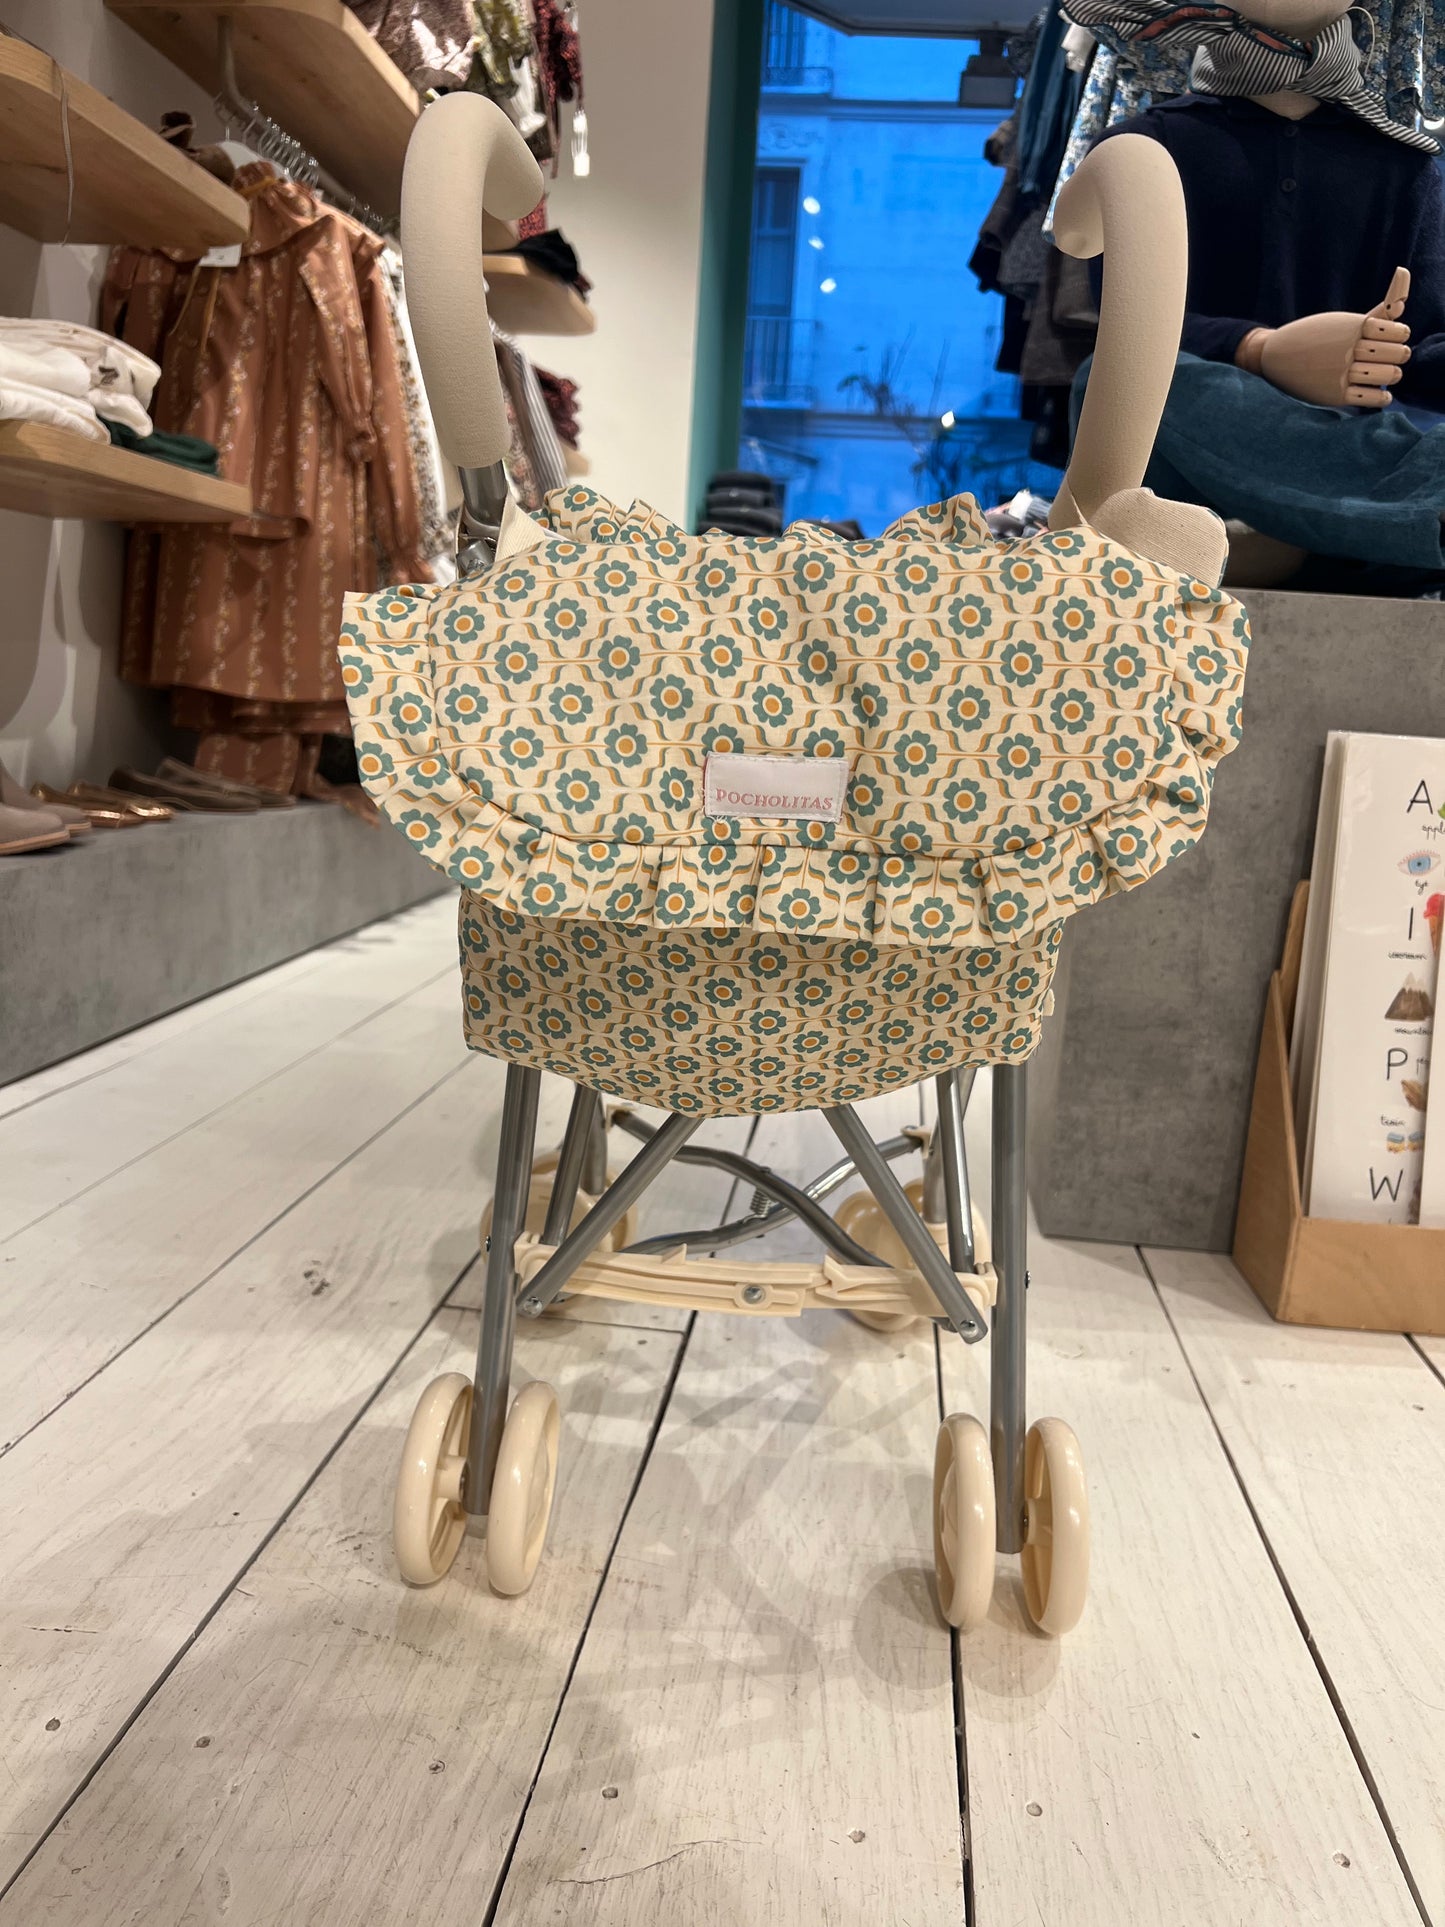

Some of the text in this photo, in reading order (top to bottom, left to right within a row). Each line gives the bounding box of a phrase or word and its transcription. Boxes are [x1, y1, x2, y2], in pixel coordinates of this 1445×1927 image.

[716, 788, 833, 810] POCHOLITAS
[1406, 779, 1433, 815] A
[1387, 1047, 1408, 1081] P
[1369, 1166, 1403, 1203] W
